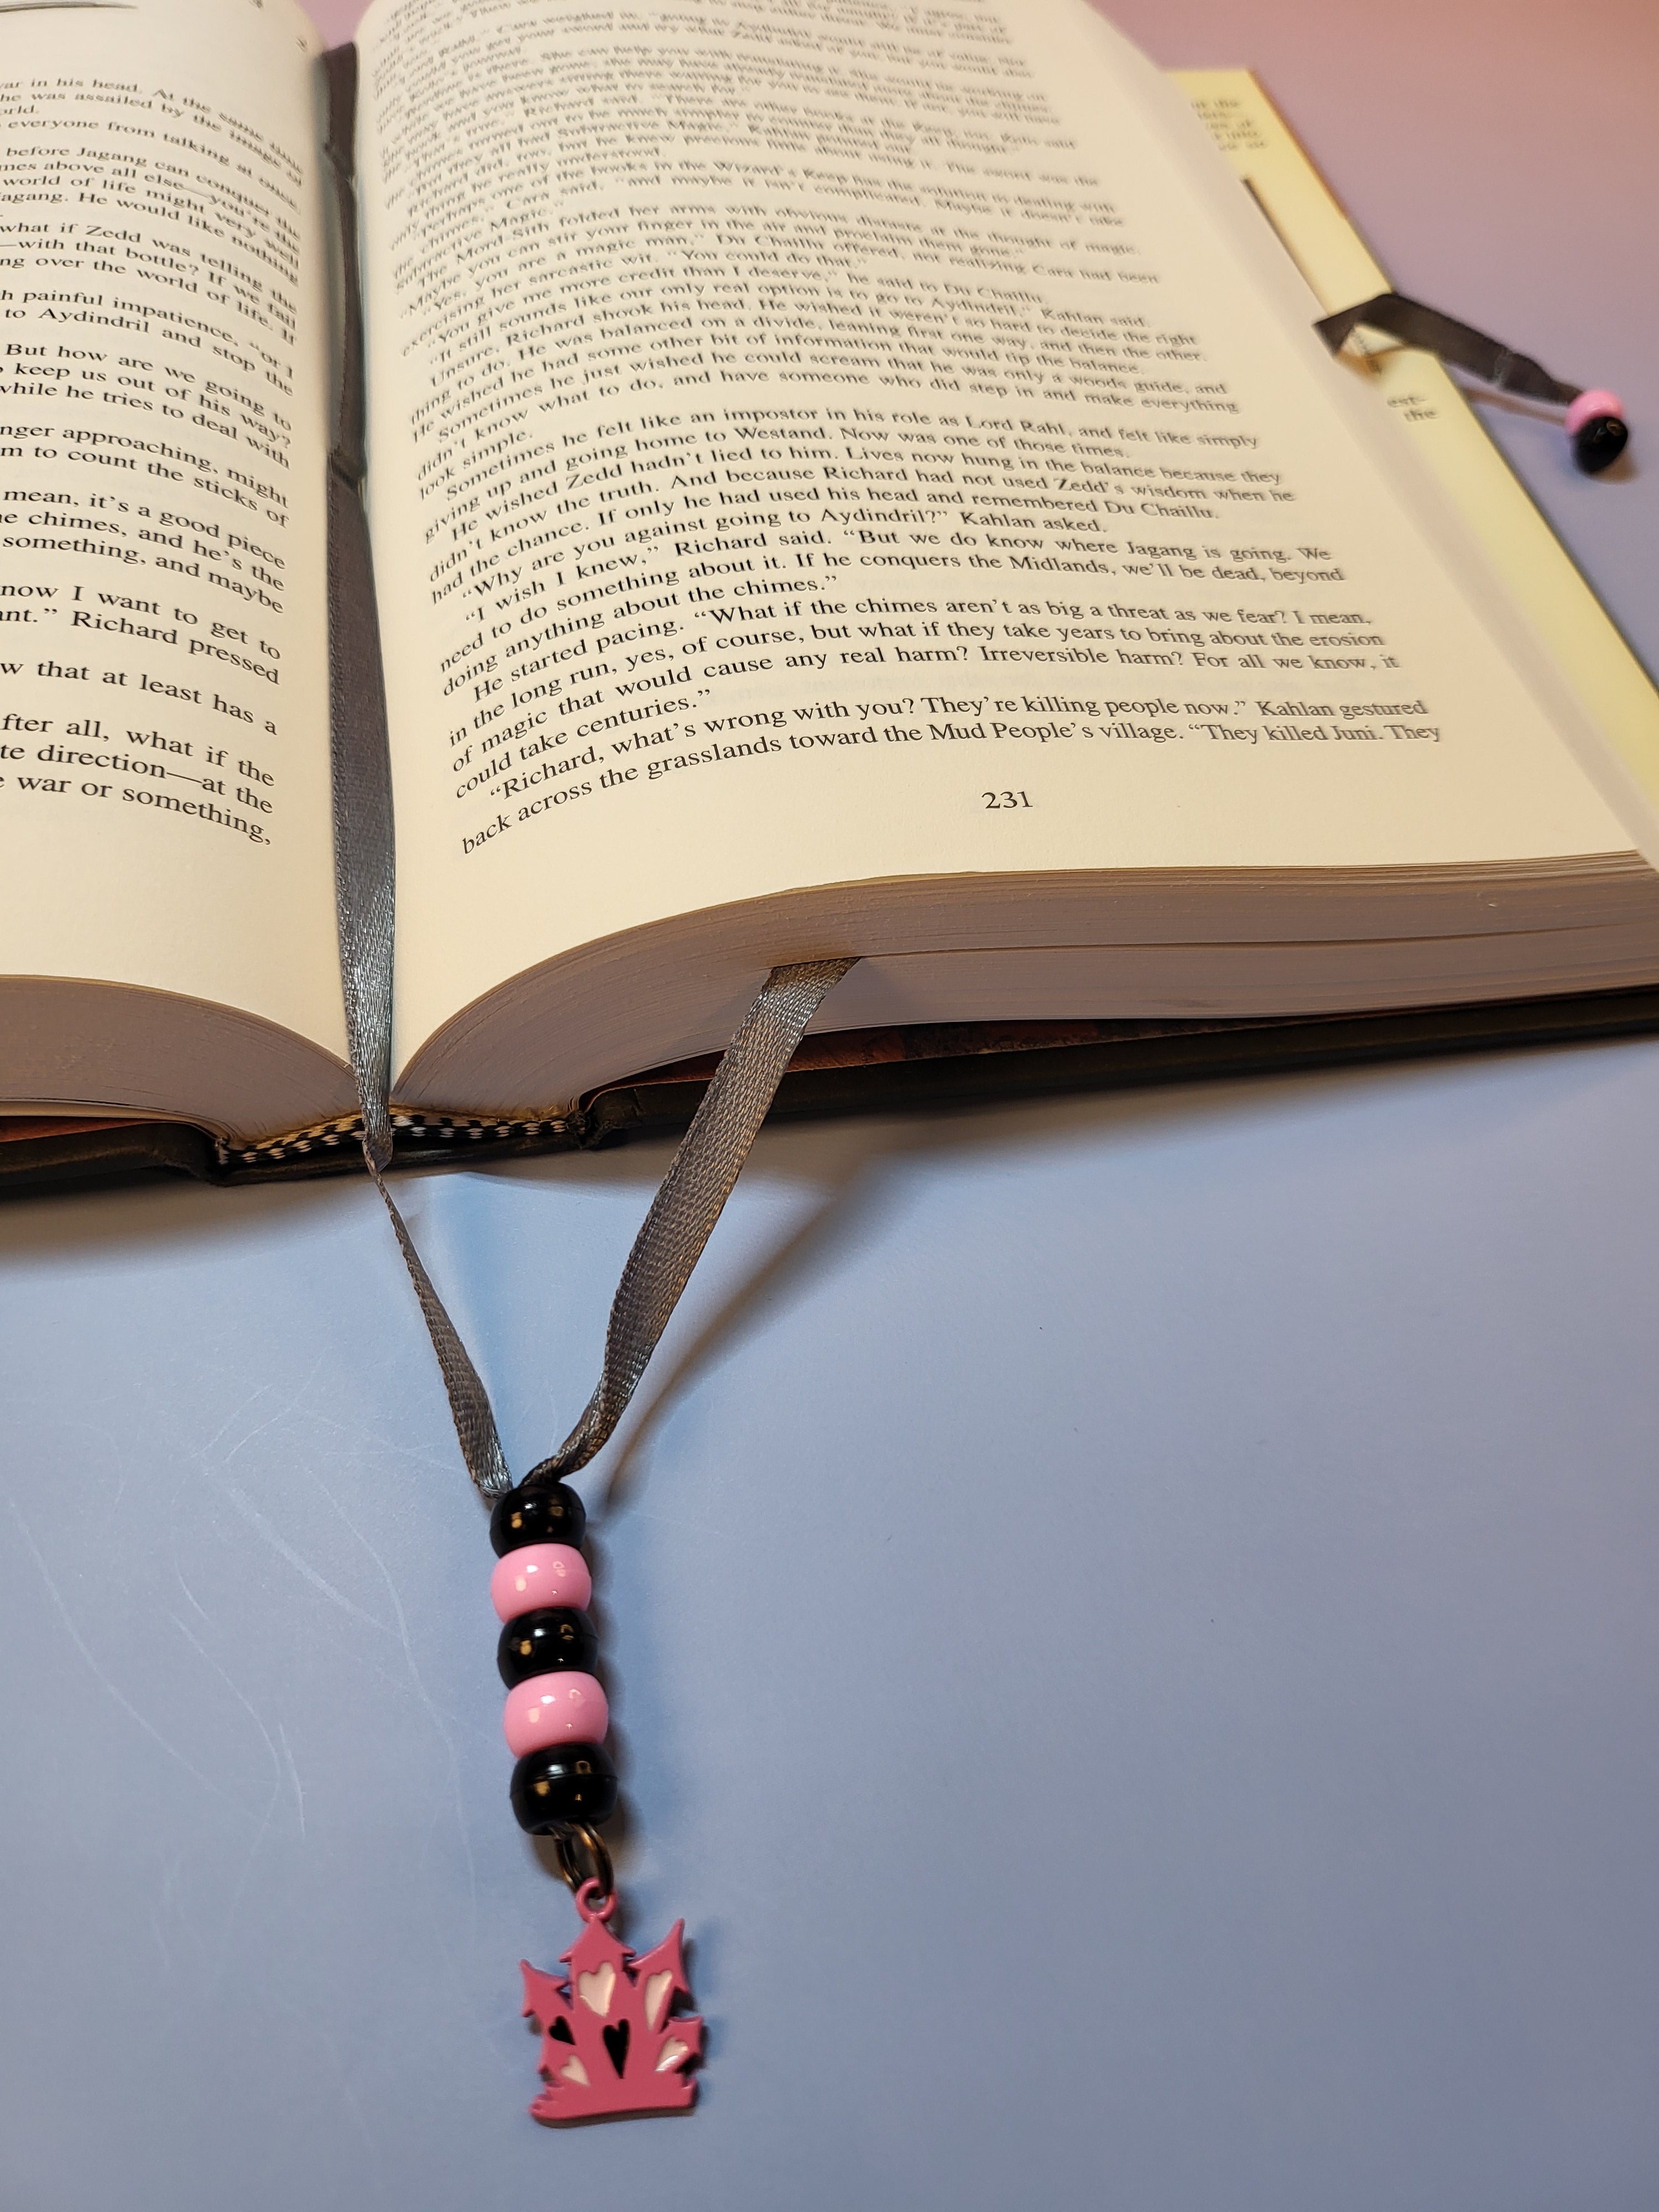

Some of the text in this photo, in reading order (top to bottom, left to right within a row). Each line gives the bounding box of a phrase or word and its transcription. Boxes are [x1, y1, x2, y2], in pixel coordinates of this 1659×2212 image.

[0, 222, 296, 315] what if Zedd was telling the
[6, 308, 293, 397] to Aydindril and stop the
[7, 344, 291, 431] But how are we going to
[420, 431, 532, 500] look simple.
[426, 426, 1129, 545] giving up and going home to Westand. Now was one of those times.
[3, 537, 283, 613] something, and maybe
[4, 491, 285, 570] mean, it’s a good piece
[463, 508, 1107, 598] “Why are you against going to Aydindril?” Kahlan asked.
[71, 611, 178, 645] Richard
[189, 639, 279, 685] pressed
[444, 575, 836, 696] doing anything about the chimes.”
[38, 661, 277, 735] that at least has a
[450, 621, 1385, 747] in the long run, yes, of course, but what if they take years to bring about the erosion
[453, 645, 1401, 772] of magic that would cause any real harm? Irreversible harm? For all we know, it
[457, 689, 709, 799] could take centuries.”
[462, 722, 1440, 854] back across the grasslands toward the Mud People’s village. “They killed Juni. They
[491, 696, 1429, 800] “Richard, what’s wrong with you? They’re killing people now.” Kahlan gestured
[18, 777, 71, 793] war
[81, 782, 113, 798] or
[123, 789, 270, 846] something,
[237, 787, 273, 814] the
[981, 791, 1034, 810] 231
